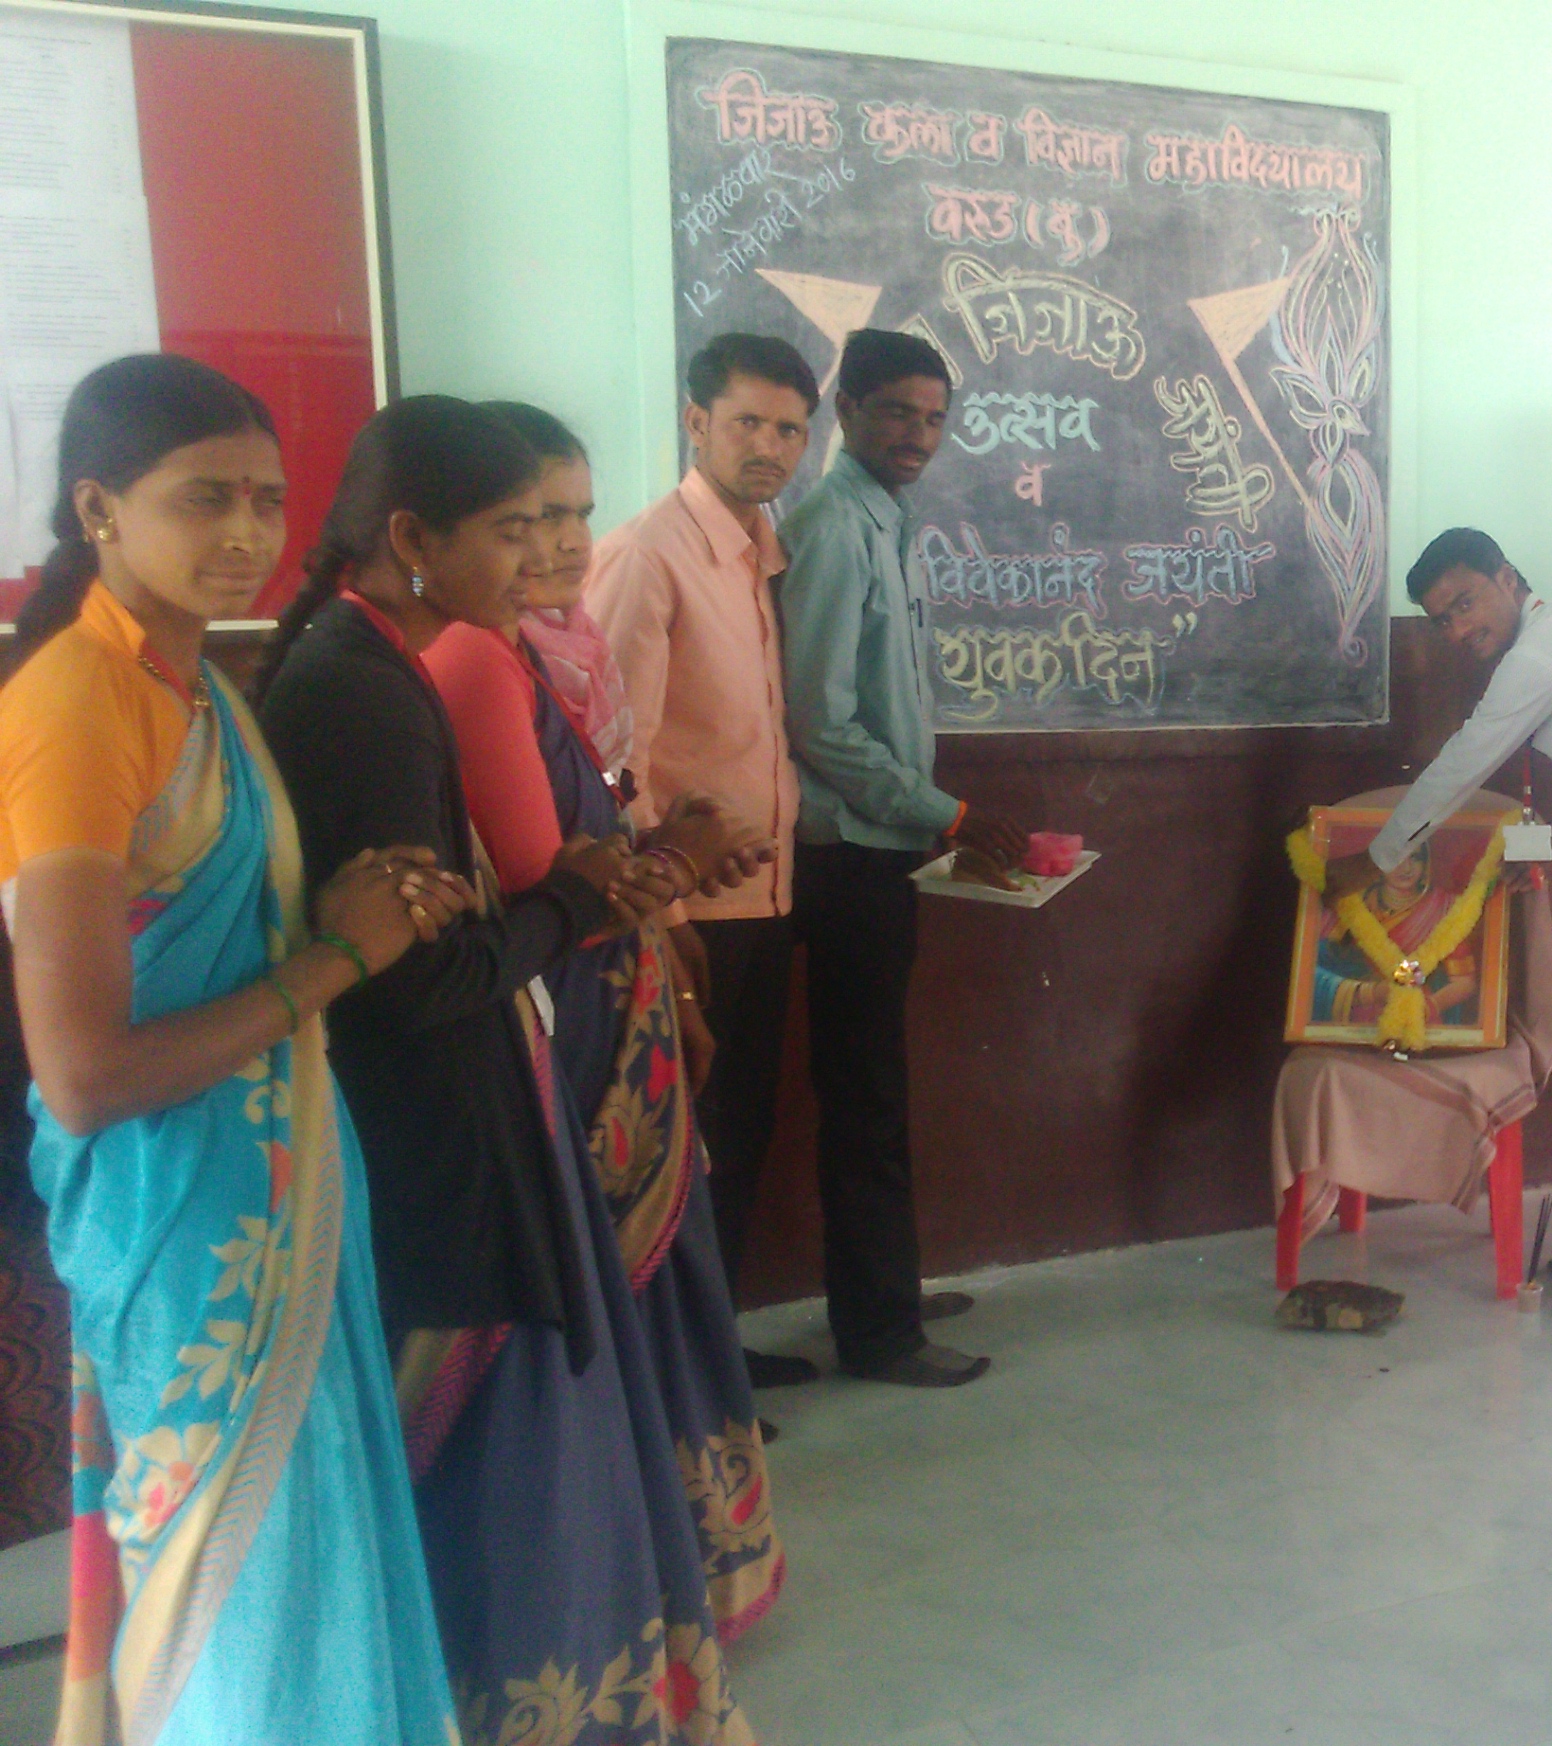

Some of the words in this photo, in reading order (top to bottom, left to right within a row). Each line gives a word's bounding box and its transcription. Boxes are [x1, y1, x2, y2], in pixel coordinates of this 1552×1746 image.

[683, 281, 722, 317] 12
[805, 156, 857, 209] 2016
[950, 392, 1101, 455] उत्सव
[919, 522, 1107, 619] विवेकानंद
[1123, 523, 1276, 606] जयंती
